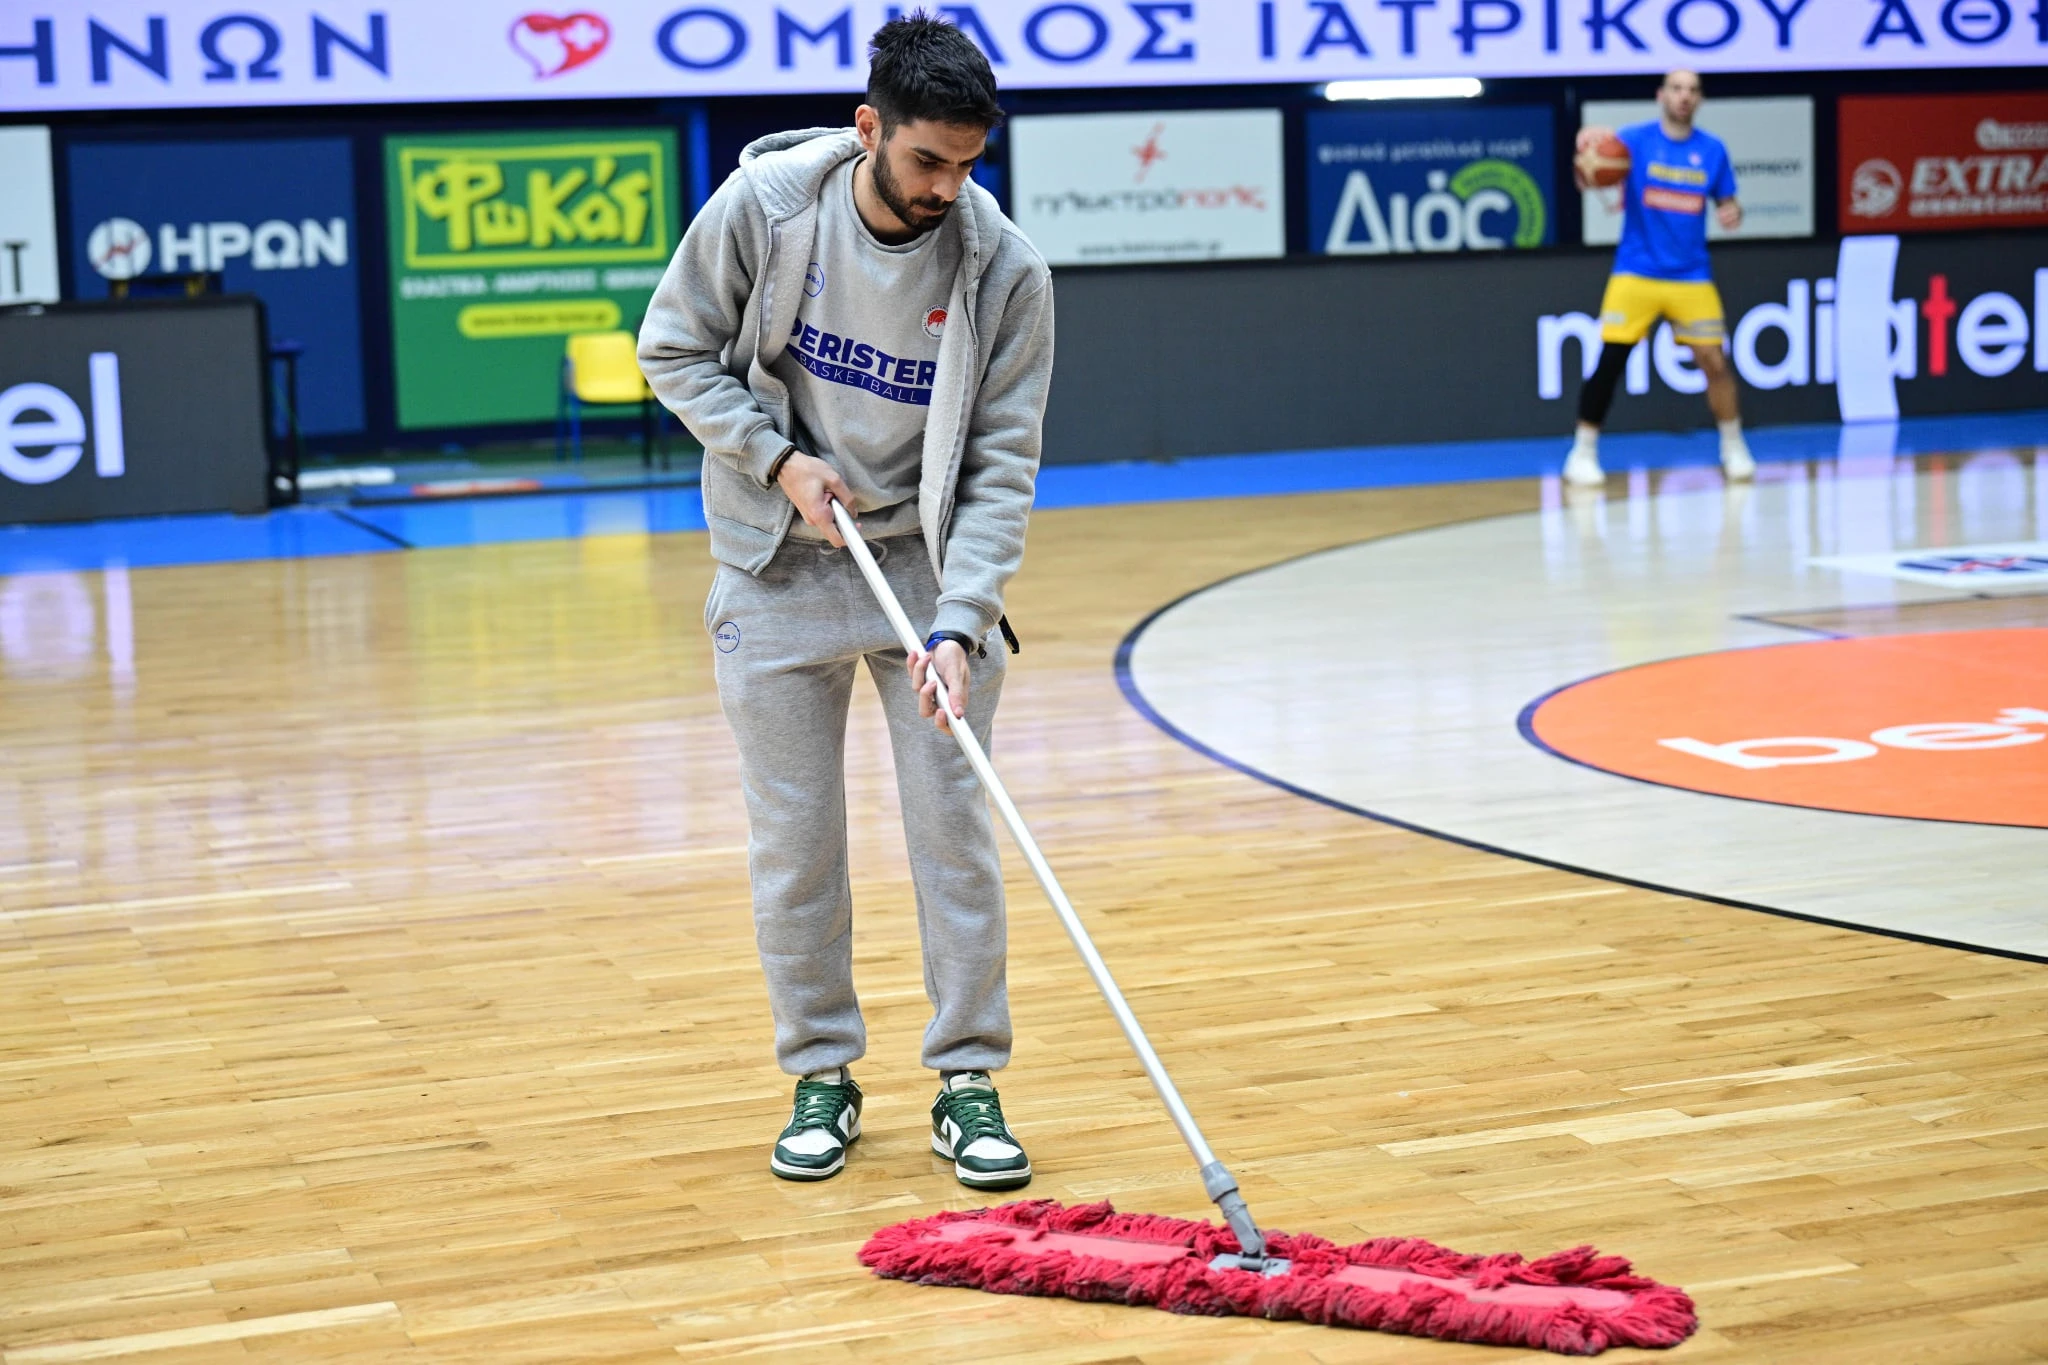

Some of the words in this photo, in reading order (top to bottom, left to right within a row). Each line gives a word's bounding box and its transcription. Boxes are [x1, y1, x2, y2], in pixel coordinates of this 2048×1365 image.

[656, 2, 1198, 70] ΟΜΛΟΣ
[1864, 0, 2048, 45] ΑΘ
[158, 217, 349, 272] ΗΡΩΝ
[800, 354, 918, 402] BASKETBALL
